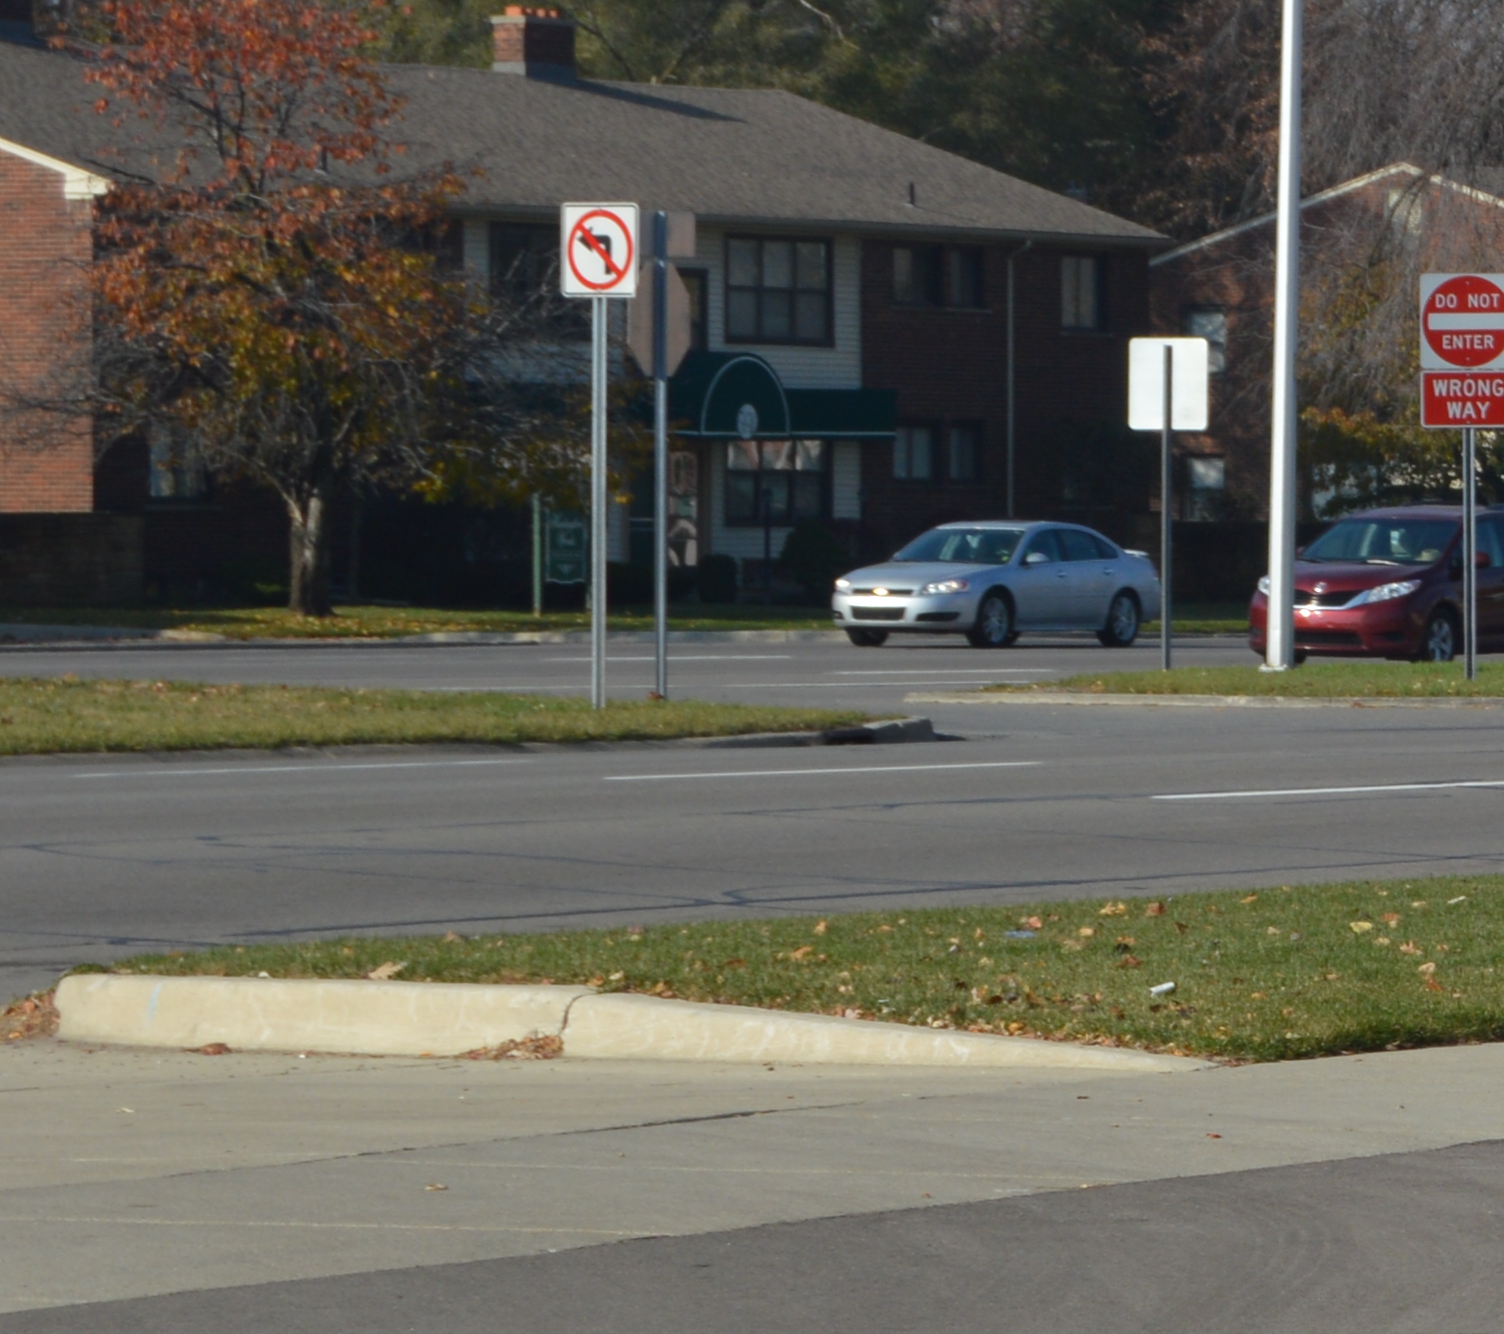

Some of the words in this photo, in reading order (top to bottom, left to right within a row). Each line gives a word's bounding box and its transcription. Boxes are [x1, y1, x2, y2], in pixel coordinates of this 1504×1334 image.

[1435, 293, 1457, 308] DO
[1467, 293, 1499, 308] NOT
[1442, 334, 1494, 349] ENTER
[1433, 379, 1504, 397] WRONG
[1446, 401, 1490, 419] WAY
